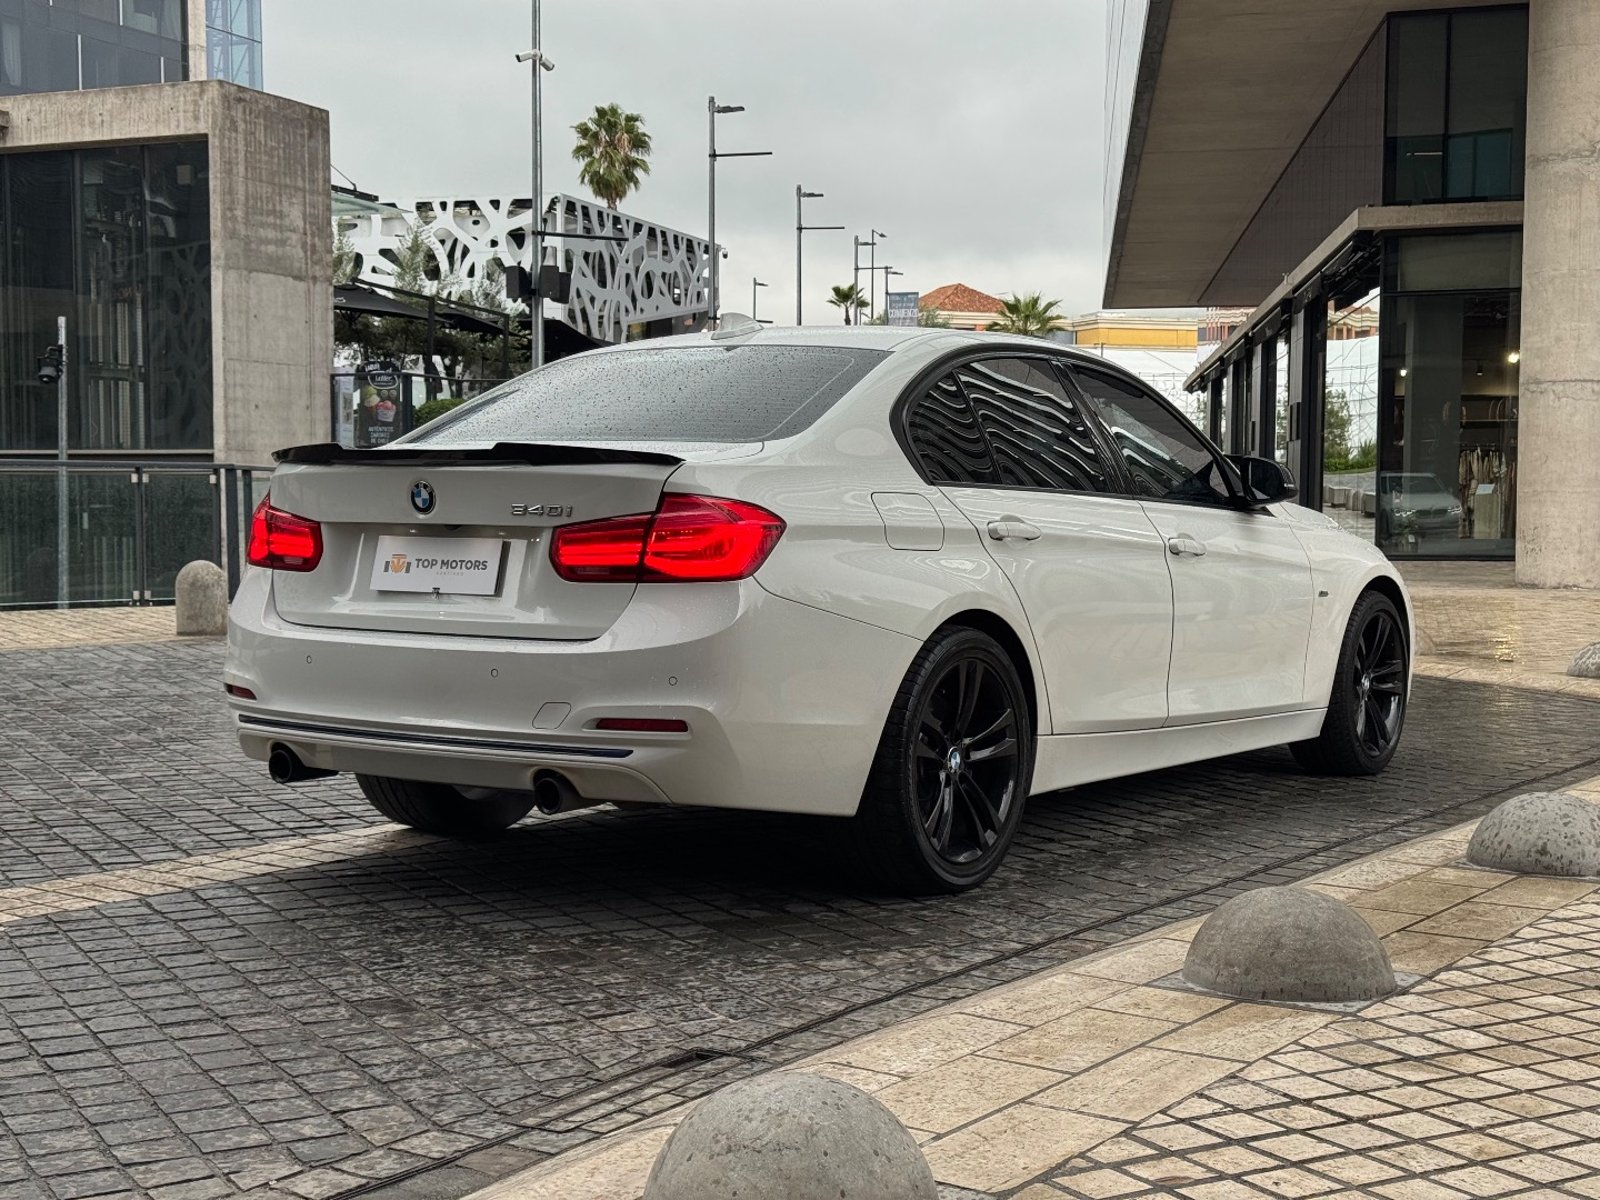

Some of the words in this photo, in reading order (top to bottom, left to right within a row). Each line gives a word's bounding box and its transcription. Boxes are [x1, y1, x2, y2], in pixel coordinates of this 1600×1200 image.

[511, 503, 573, 518] 340i
[415, 558, 438, 569] TOP
[440, 559, 488, 571] MOTORS
